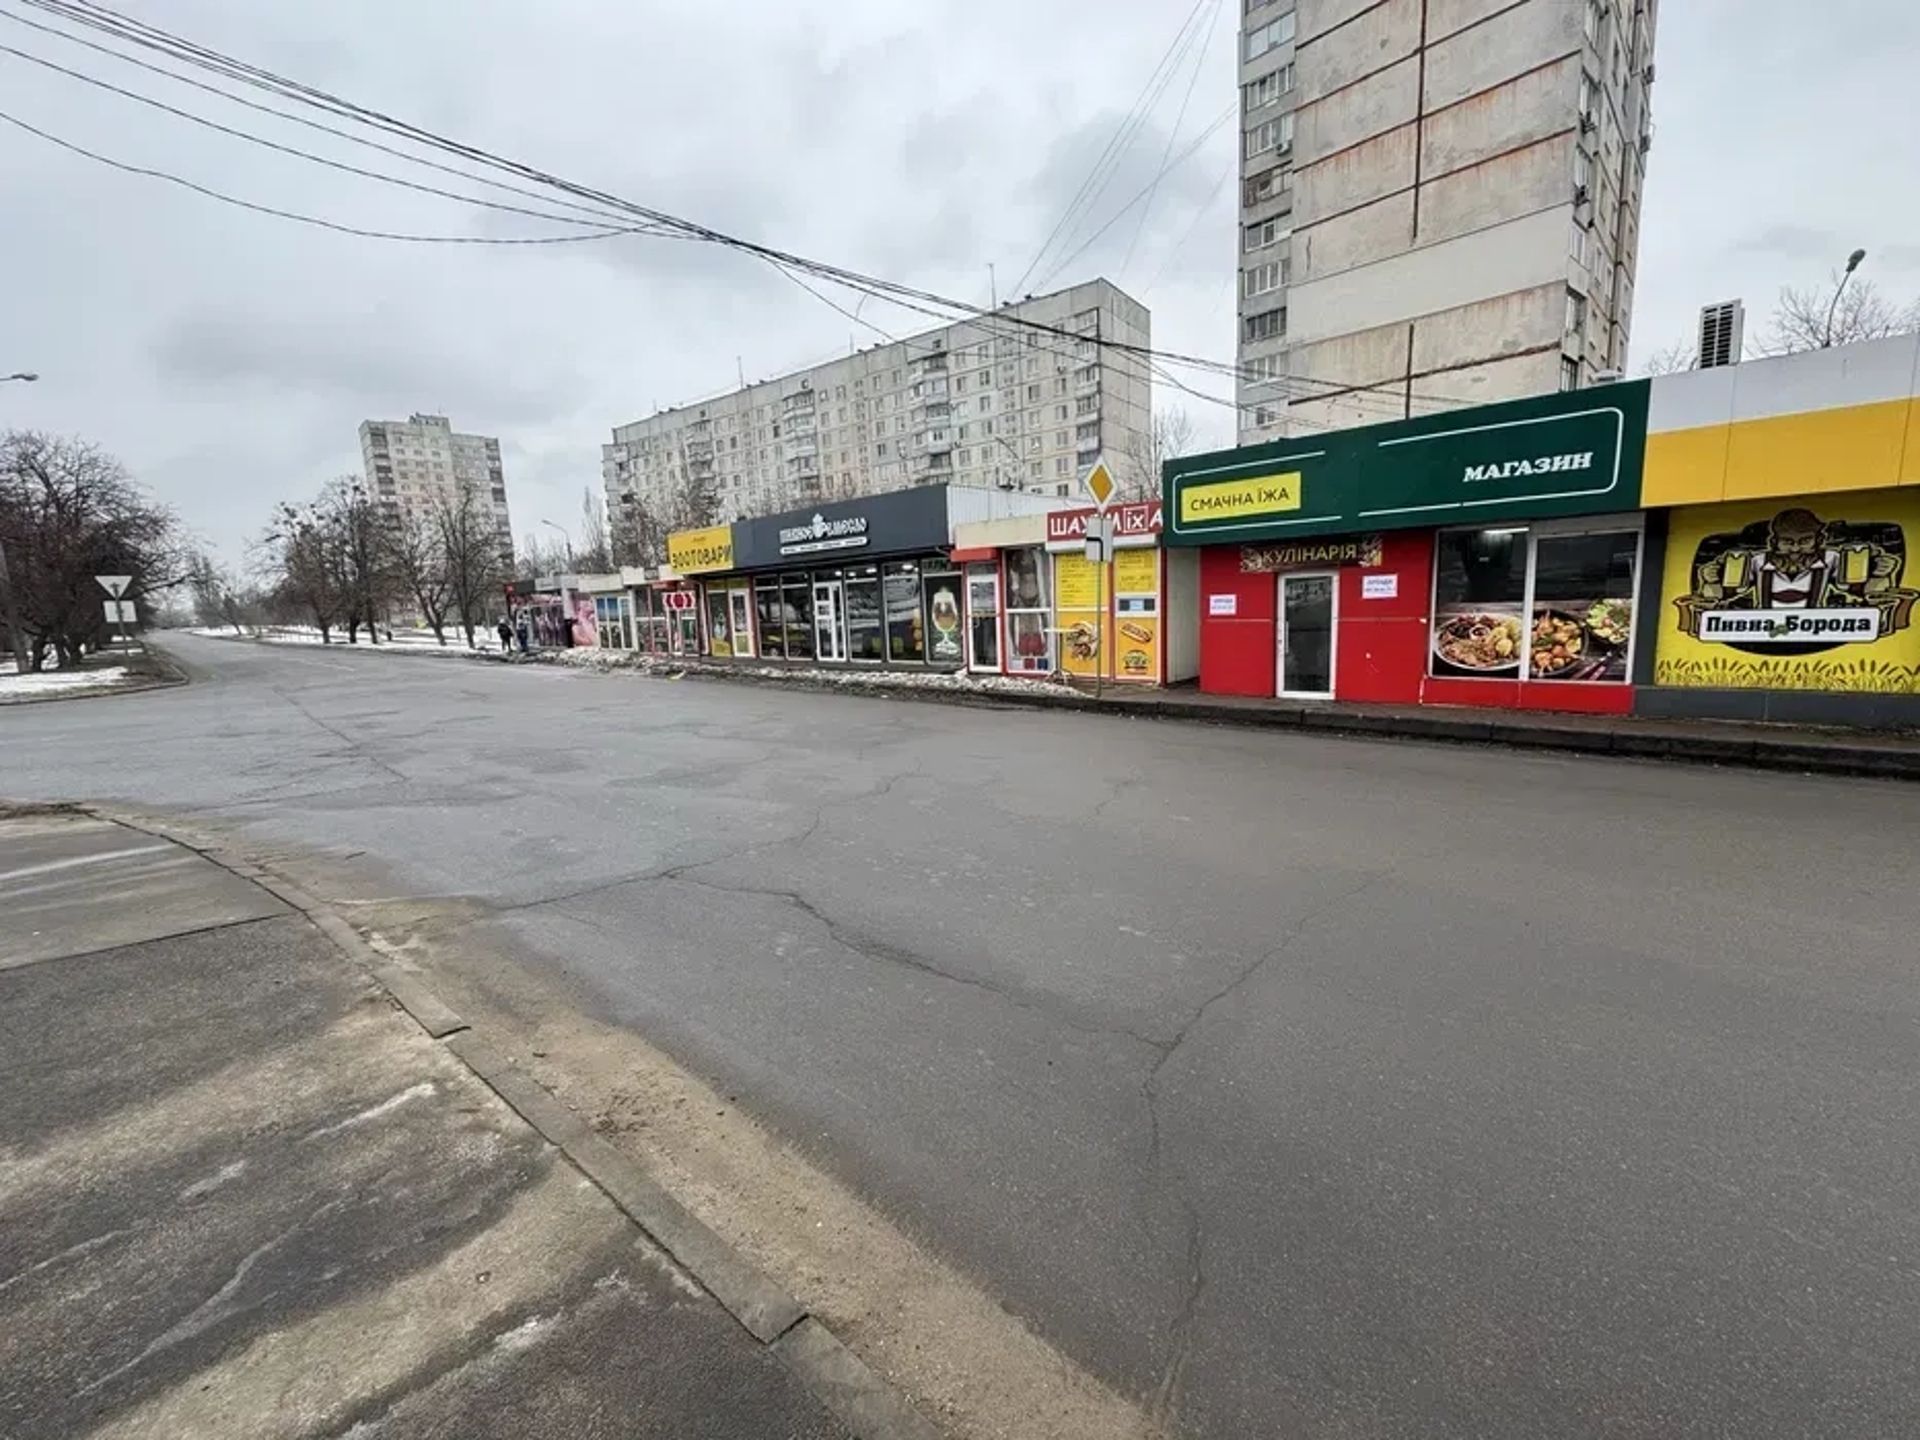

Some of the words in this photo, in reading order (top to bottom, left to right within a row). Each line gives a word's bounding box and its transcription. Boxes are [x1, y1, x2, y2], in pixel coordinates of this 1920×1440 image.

[1462, 452, 1593, 482] МАГАЗИН
[1190, 493, 1254, 511] СМАЧНА
[1257, 487, 1289, 503] ЇЖА
[1262, 544, 1357, 563] КУЛІНАРІЯ
[1706, 617, 1775, 633] Пивна
[1785, 615, 1871, 634] Борода
